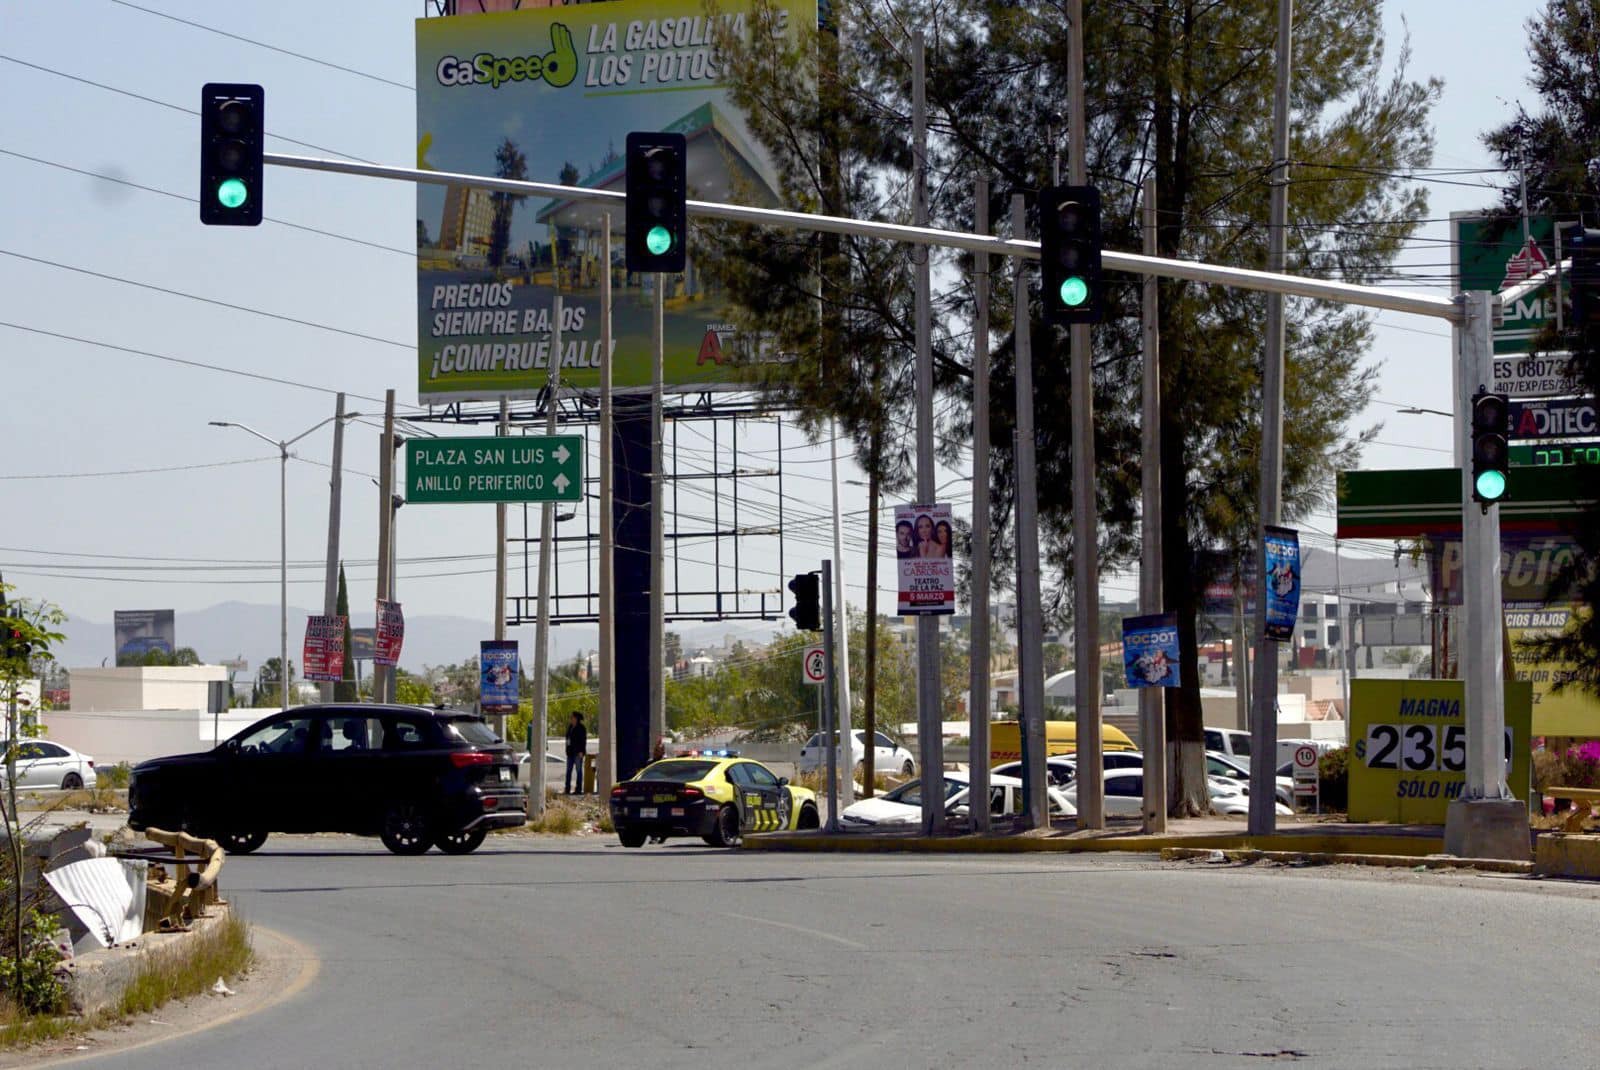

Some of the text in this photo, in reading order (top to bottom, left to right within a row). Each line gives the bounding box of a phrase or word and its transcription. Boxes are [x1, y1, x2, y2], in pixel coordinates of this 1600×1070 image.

[586, 22, 617, 54] LA
[585, 54, 632, 87] LOS
[431, 282, 513, 309] PRECIOS
[432, 310, 518, 337] SIEMPRE
[415, 449, 545, 465] PLAZA SAN LUIS
[415, 475, 544, 491] ANILLO PERIFERICO
[917, 592, 944, 600] MARZO
[1532, 612, 1566, 627] BAJOS
[1399, 698, 1461, 717] MAGNA
[1301, 751, 1312, 760] 10
[1397, 776, 1441, 799] SÓLO
